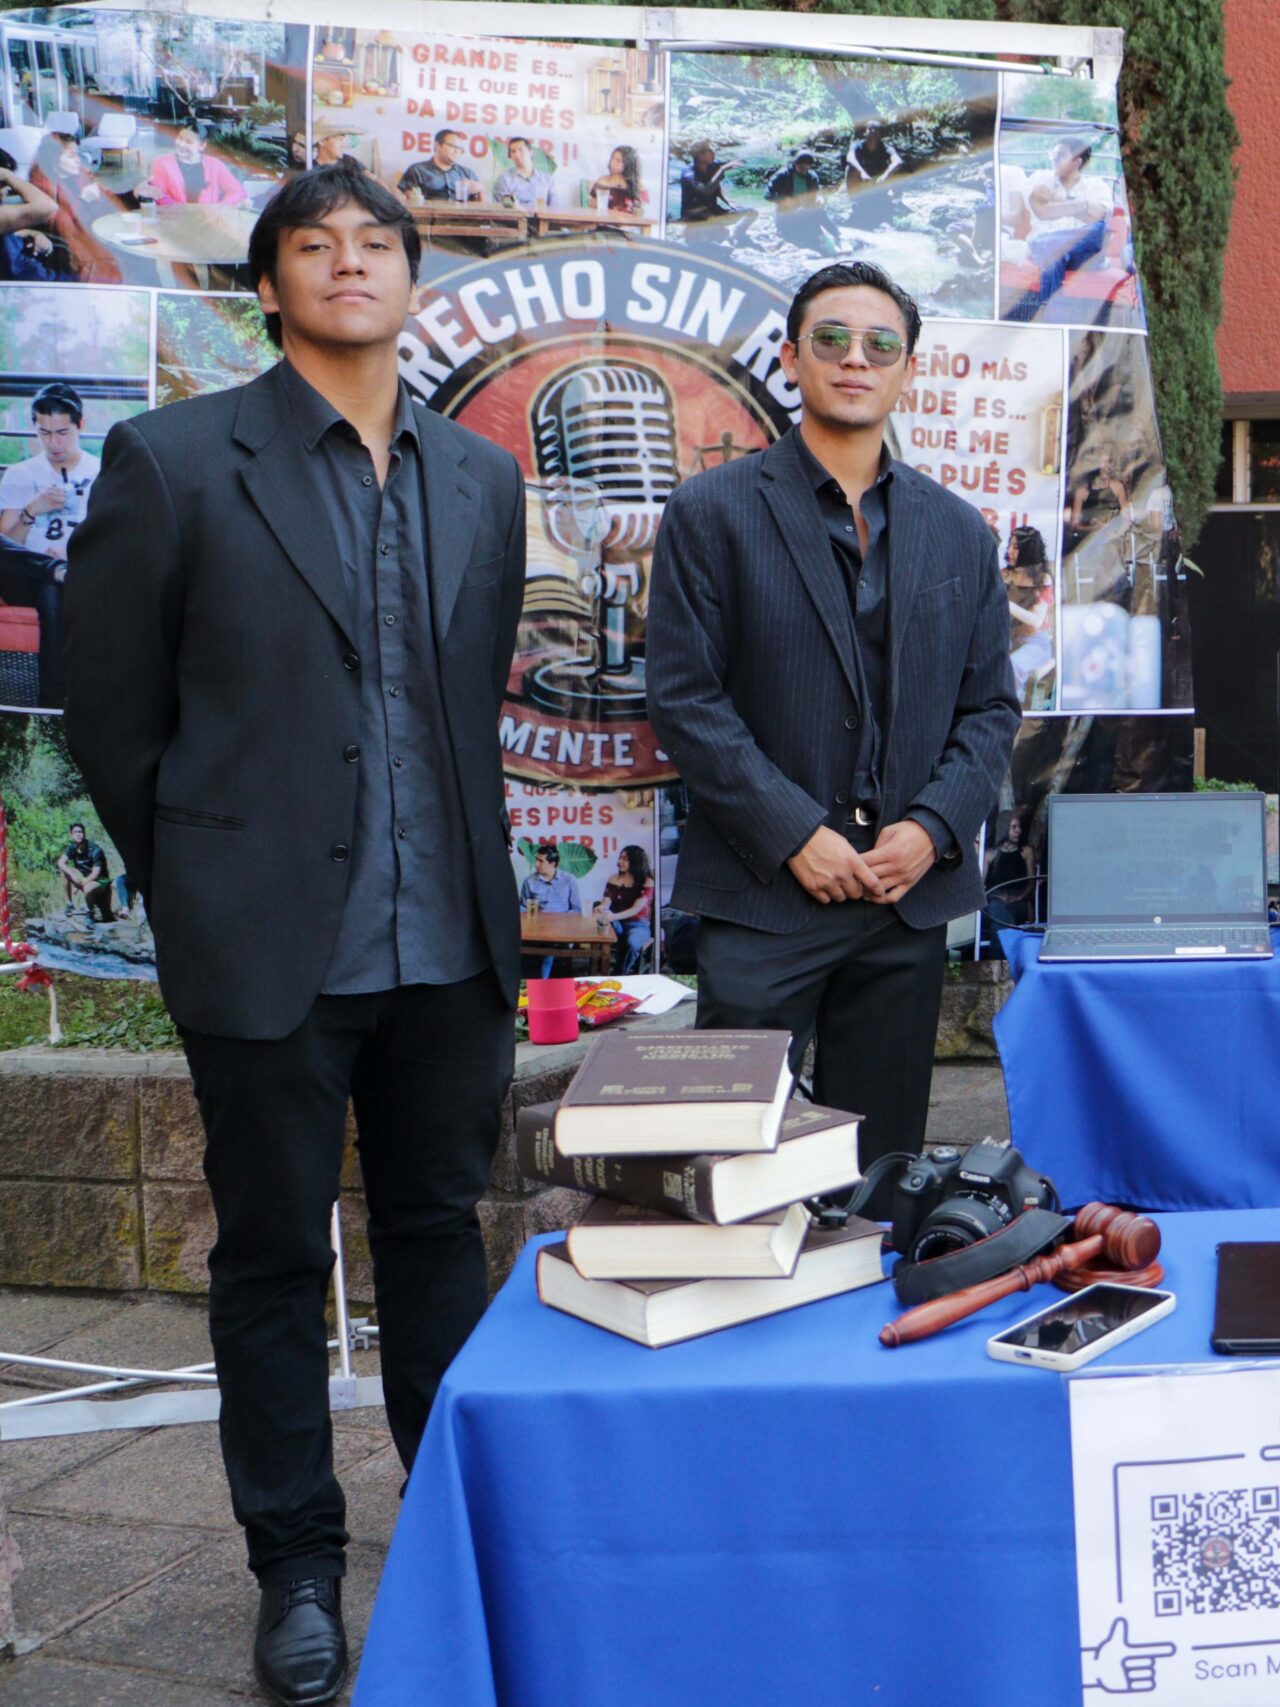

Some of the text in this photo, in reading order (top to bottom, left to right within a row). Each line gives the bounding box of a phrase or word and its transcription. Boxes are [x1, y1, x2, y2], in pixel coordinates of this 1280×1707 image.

[411, 43, 518, 73] GRANDE
[445, 76, 470, 93] EL
[478, 78, 519, 96] QUE
[528, 83, 560, 100] ME
[406, 97, 435, 118] DA
[402, 130, 432, 153] DE
[397, 259, 606, 407] RECHO
[626, 262, 746, 347] SIN
[913, 344, 1028, 381] EÑO MÁS
[911, 426, 1009, 454] QUE ME
[509, 801, 614, 826] ESPUÉS
[959, 1171, 991, 1184] Canon
[1195, 1659, 1257, 1680] Scan
